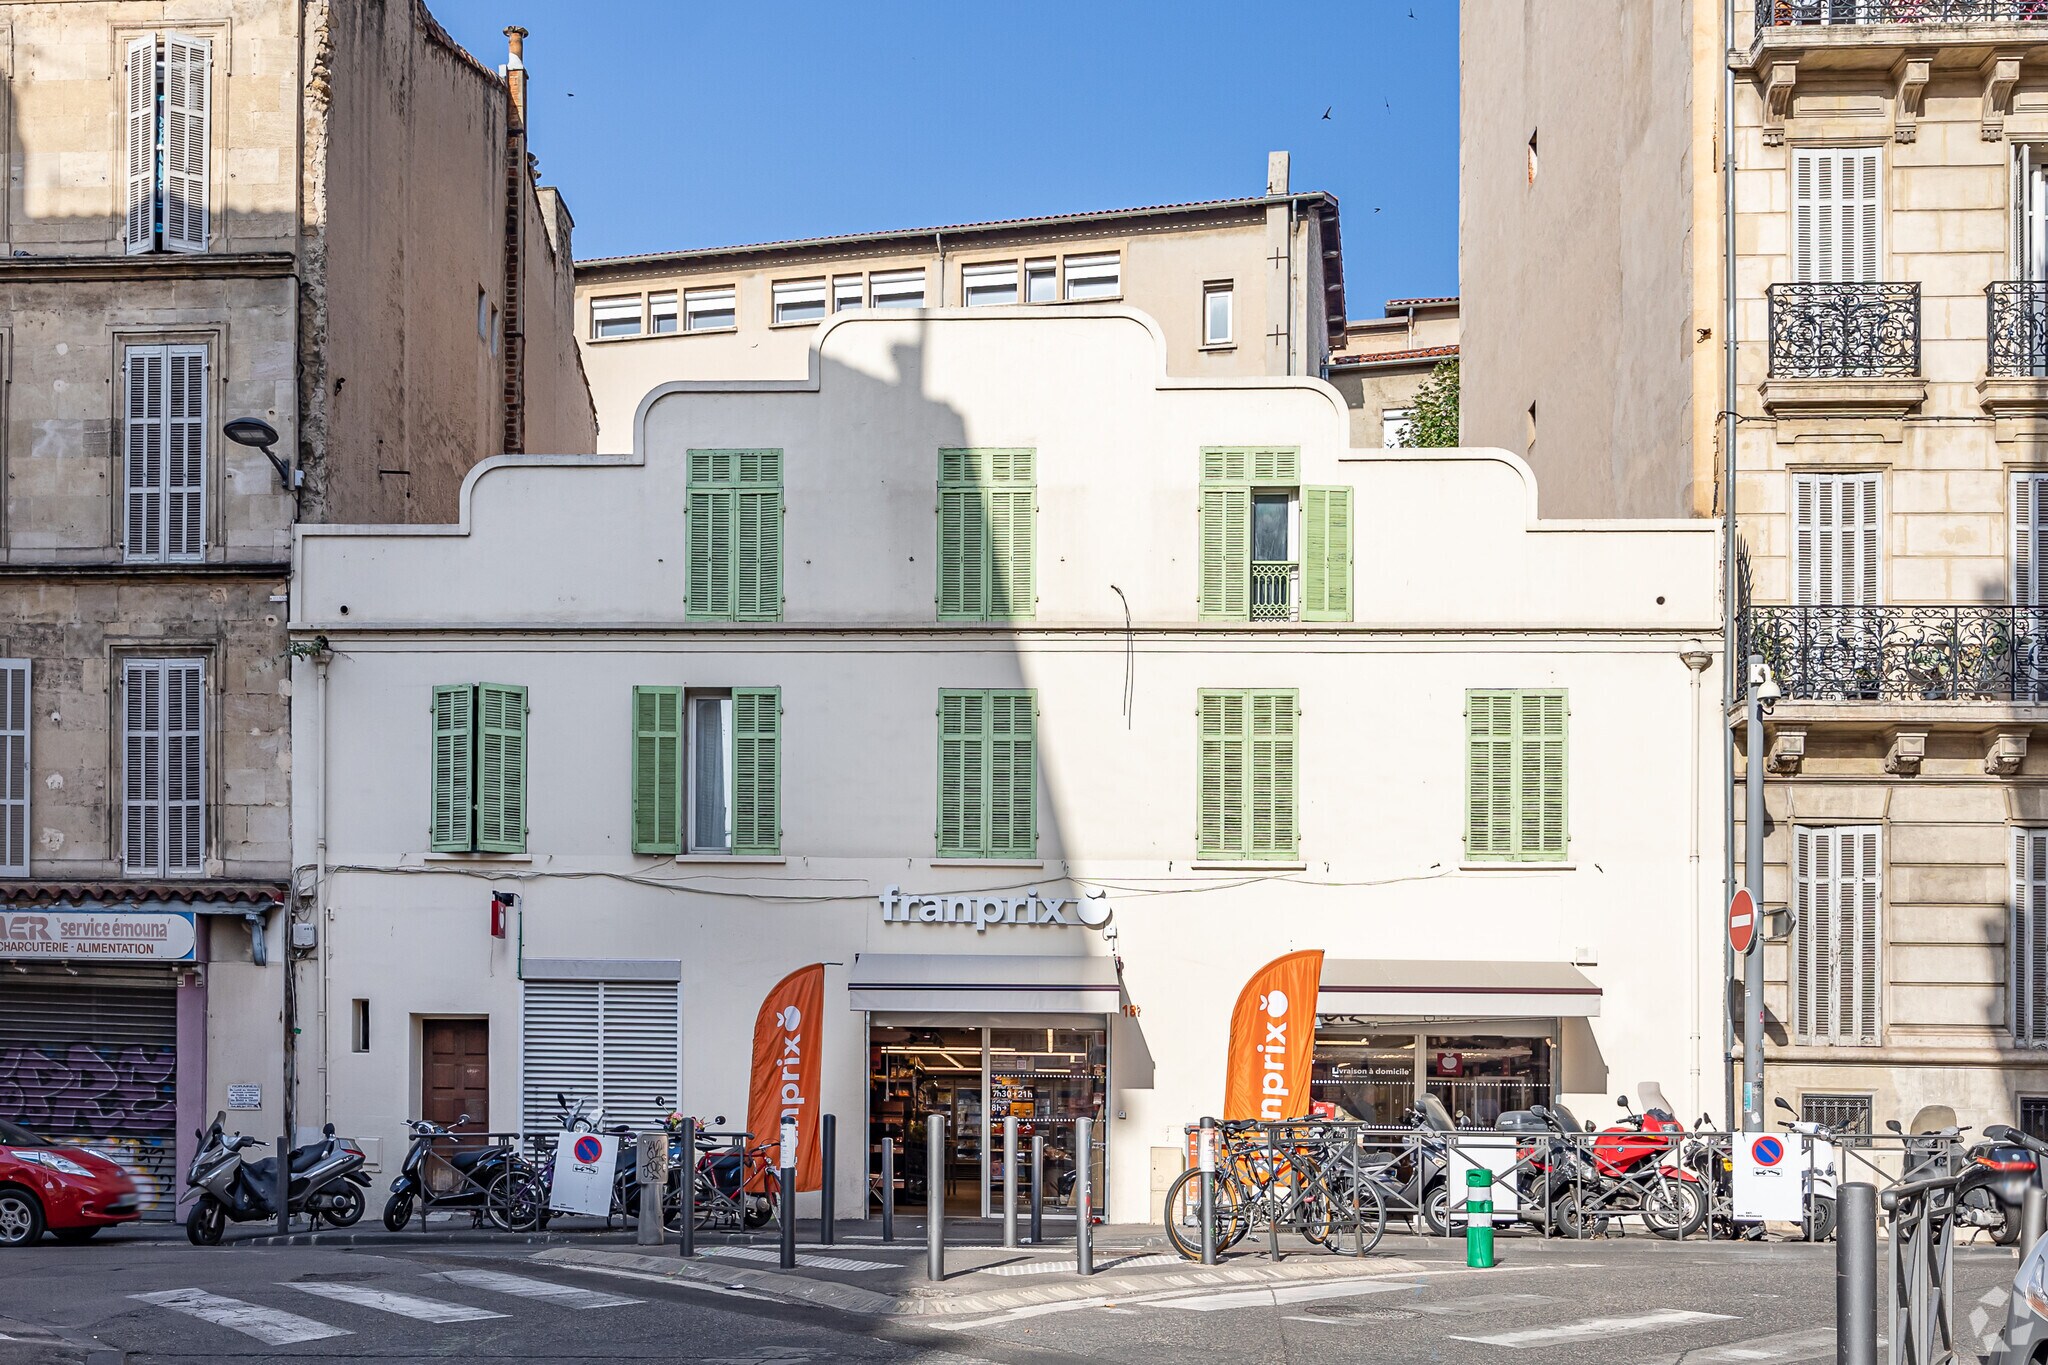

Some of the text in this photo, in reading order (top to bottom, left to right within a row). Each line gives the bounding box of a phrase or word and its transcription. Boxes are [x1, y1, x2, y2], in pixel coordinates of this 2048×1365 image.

[879, 884, 1067, 934] franprix
[76, 943, 154, 954] ALIMENTATION
[1332, 1066, 1367, 1075] Livraison
[1368, 1067, 1374, 1075] à
[1017, 1090, 1033, 1099] 21h
